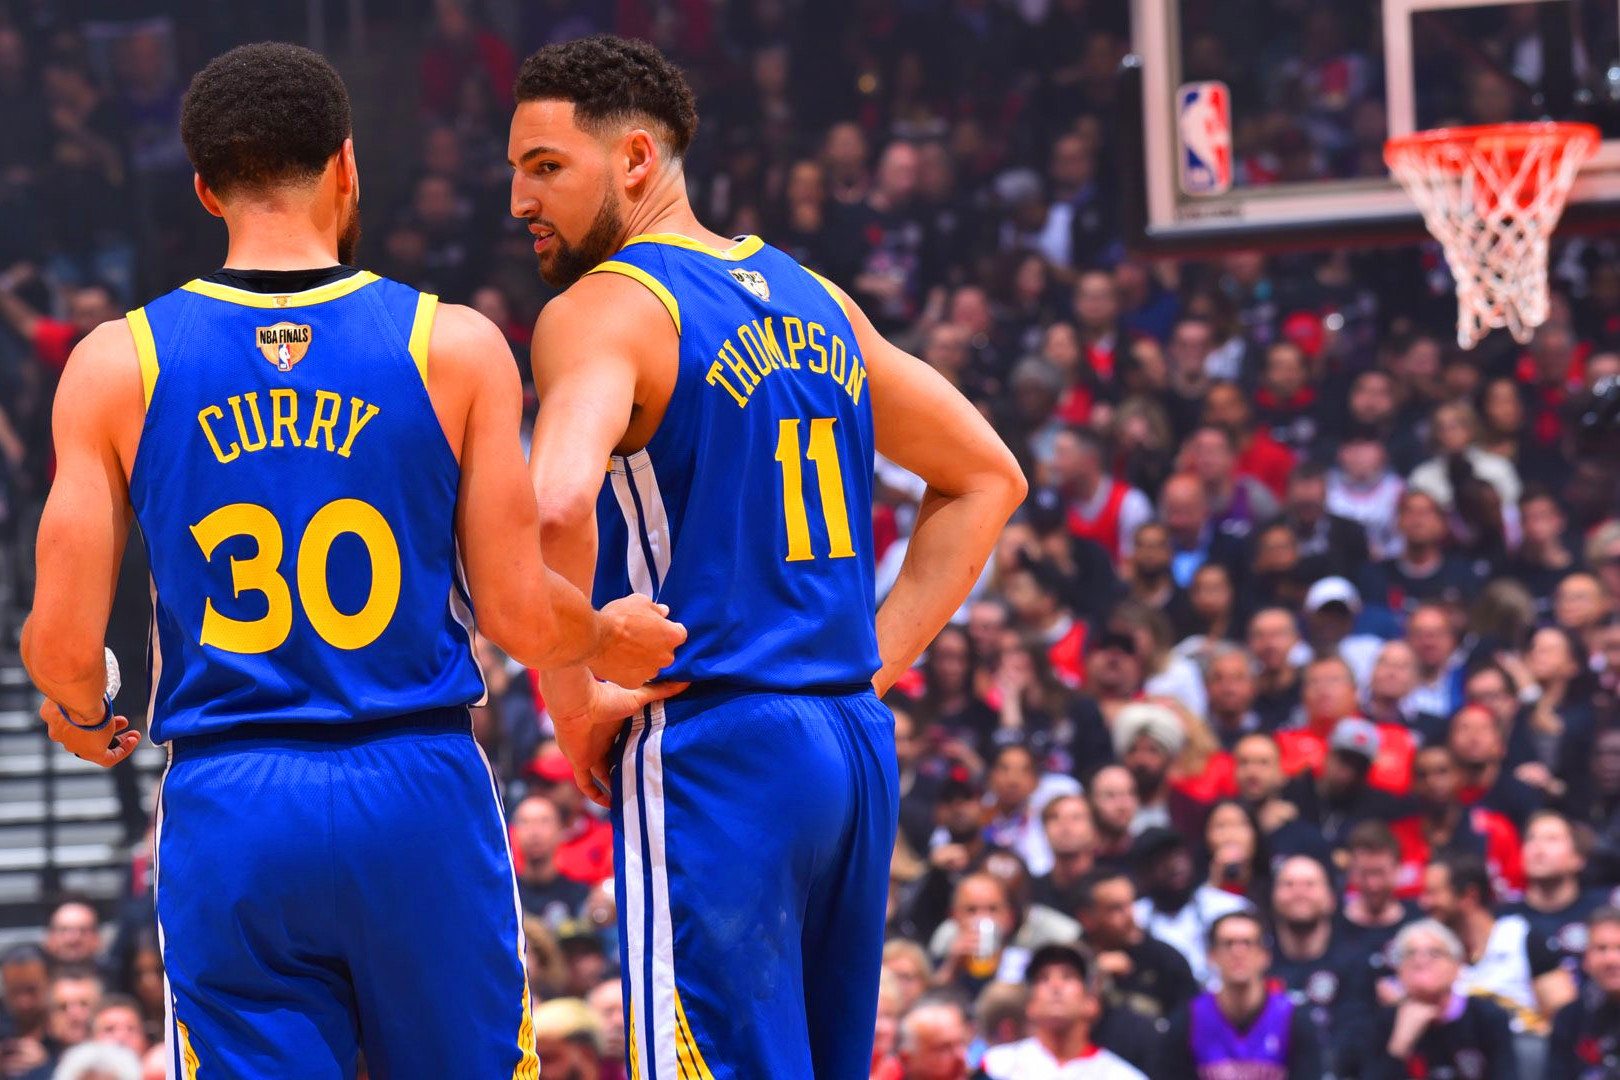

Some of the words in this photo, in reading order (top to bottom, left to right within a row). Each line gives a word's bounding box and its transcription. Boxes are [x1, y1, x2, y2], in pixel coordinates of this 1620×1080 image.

[260, 330, 278, 345] NBA
[279, 327, 309, 344] FINALS
[705, 316, 867, 409] THOMPSON
[198, 388, 380, 464] CURRY
[774, 417, 856, 562] 11
[189, 498, 402, 654] 30
